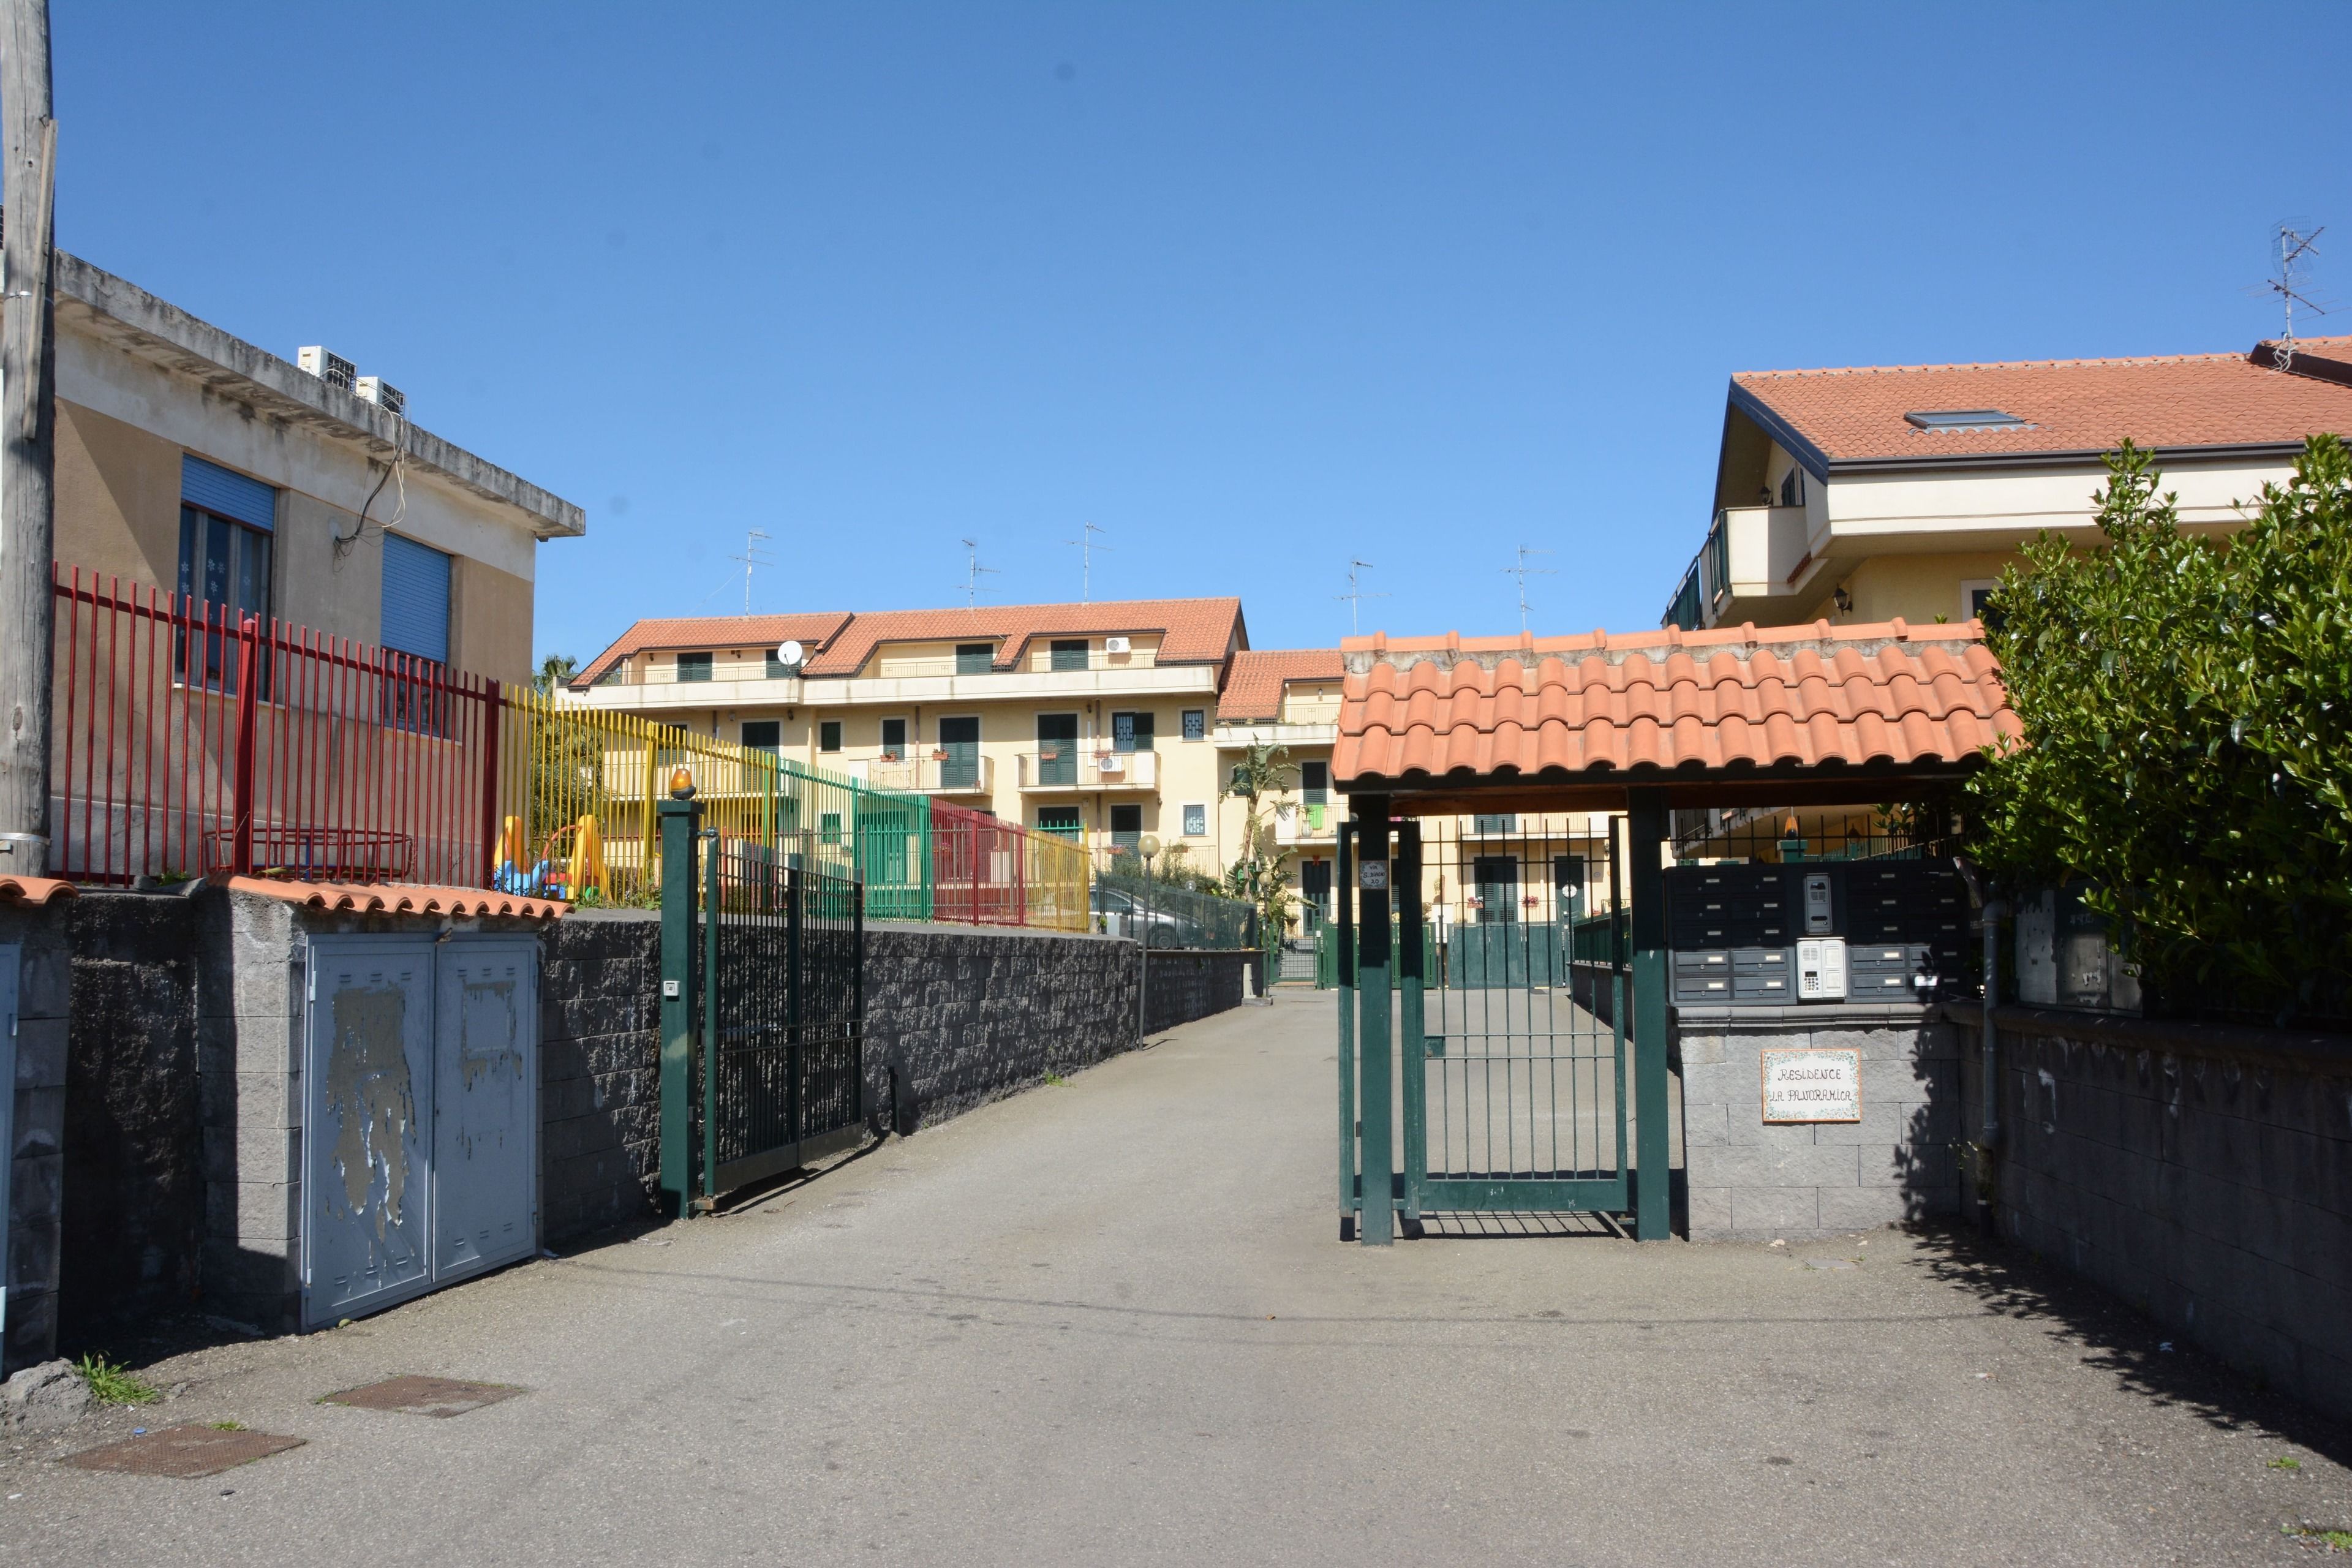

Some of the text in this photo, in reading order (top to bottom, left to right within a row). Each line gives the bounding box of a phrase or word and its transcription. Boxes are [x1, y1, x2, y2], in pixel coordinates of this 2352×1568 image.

[1777, 1068, 1841, 1081] RESIDENCE
[1770, 1088, 1852, 1102] LA PANORAMICA
